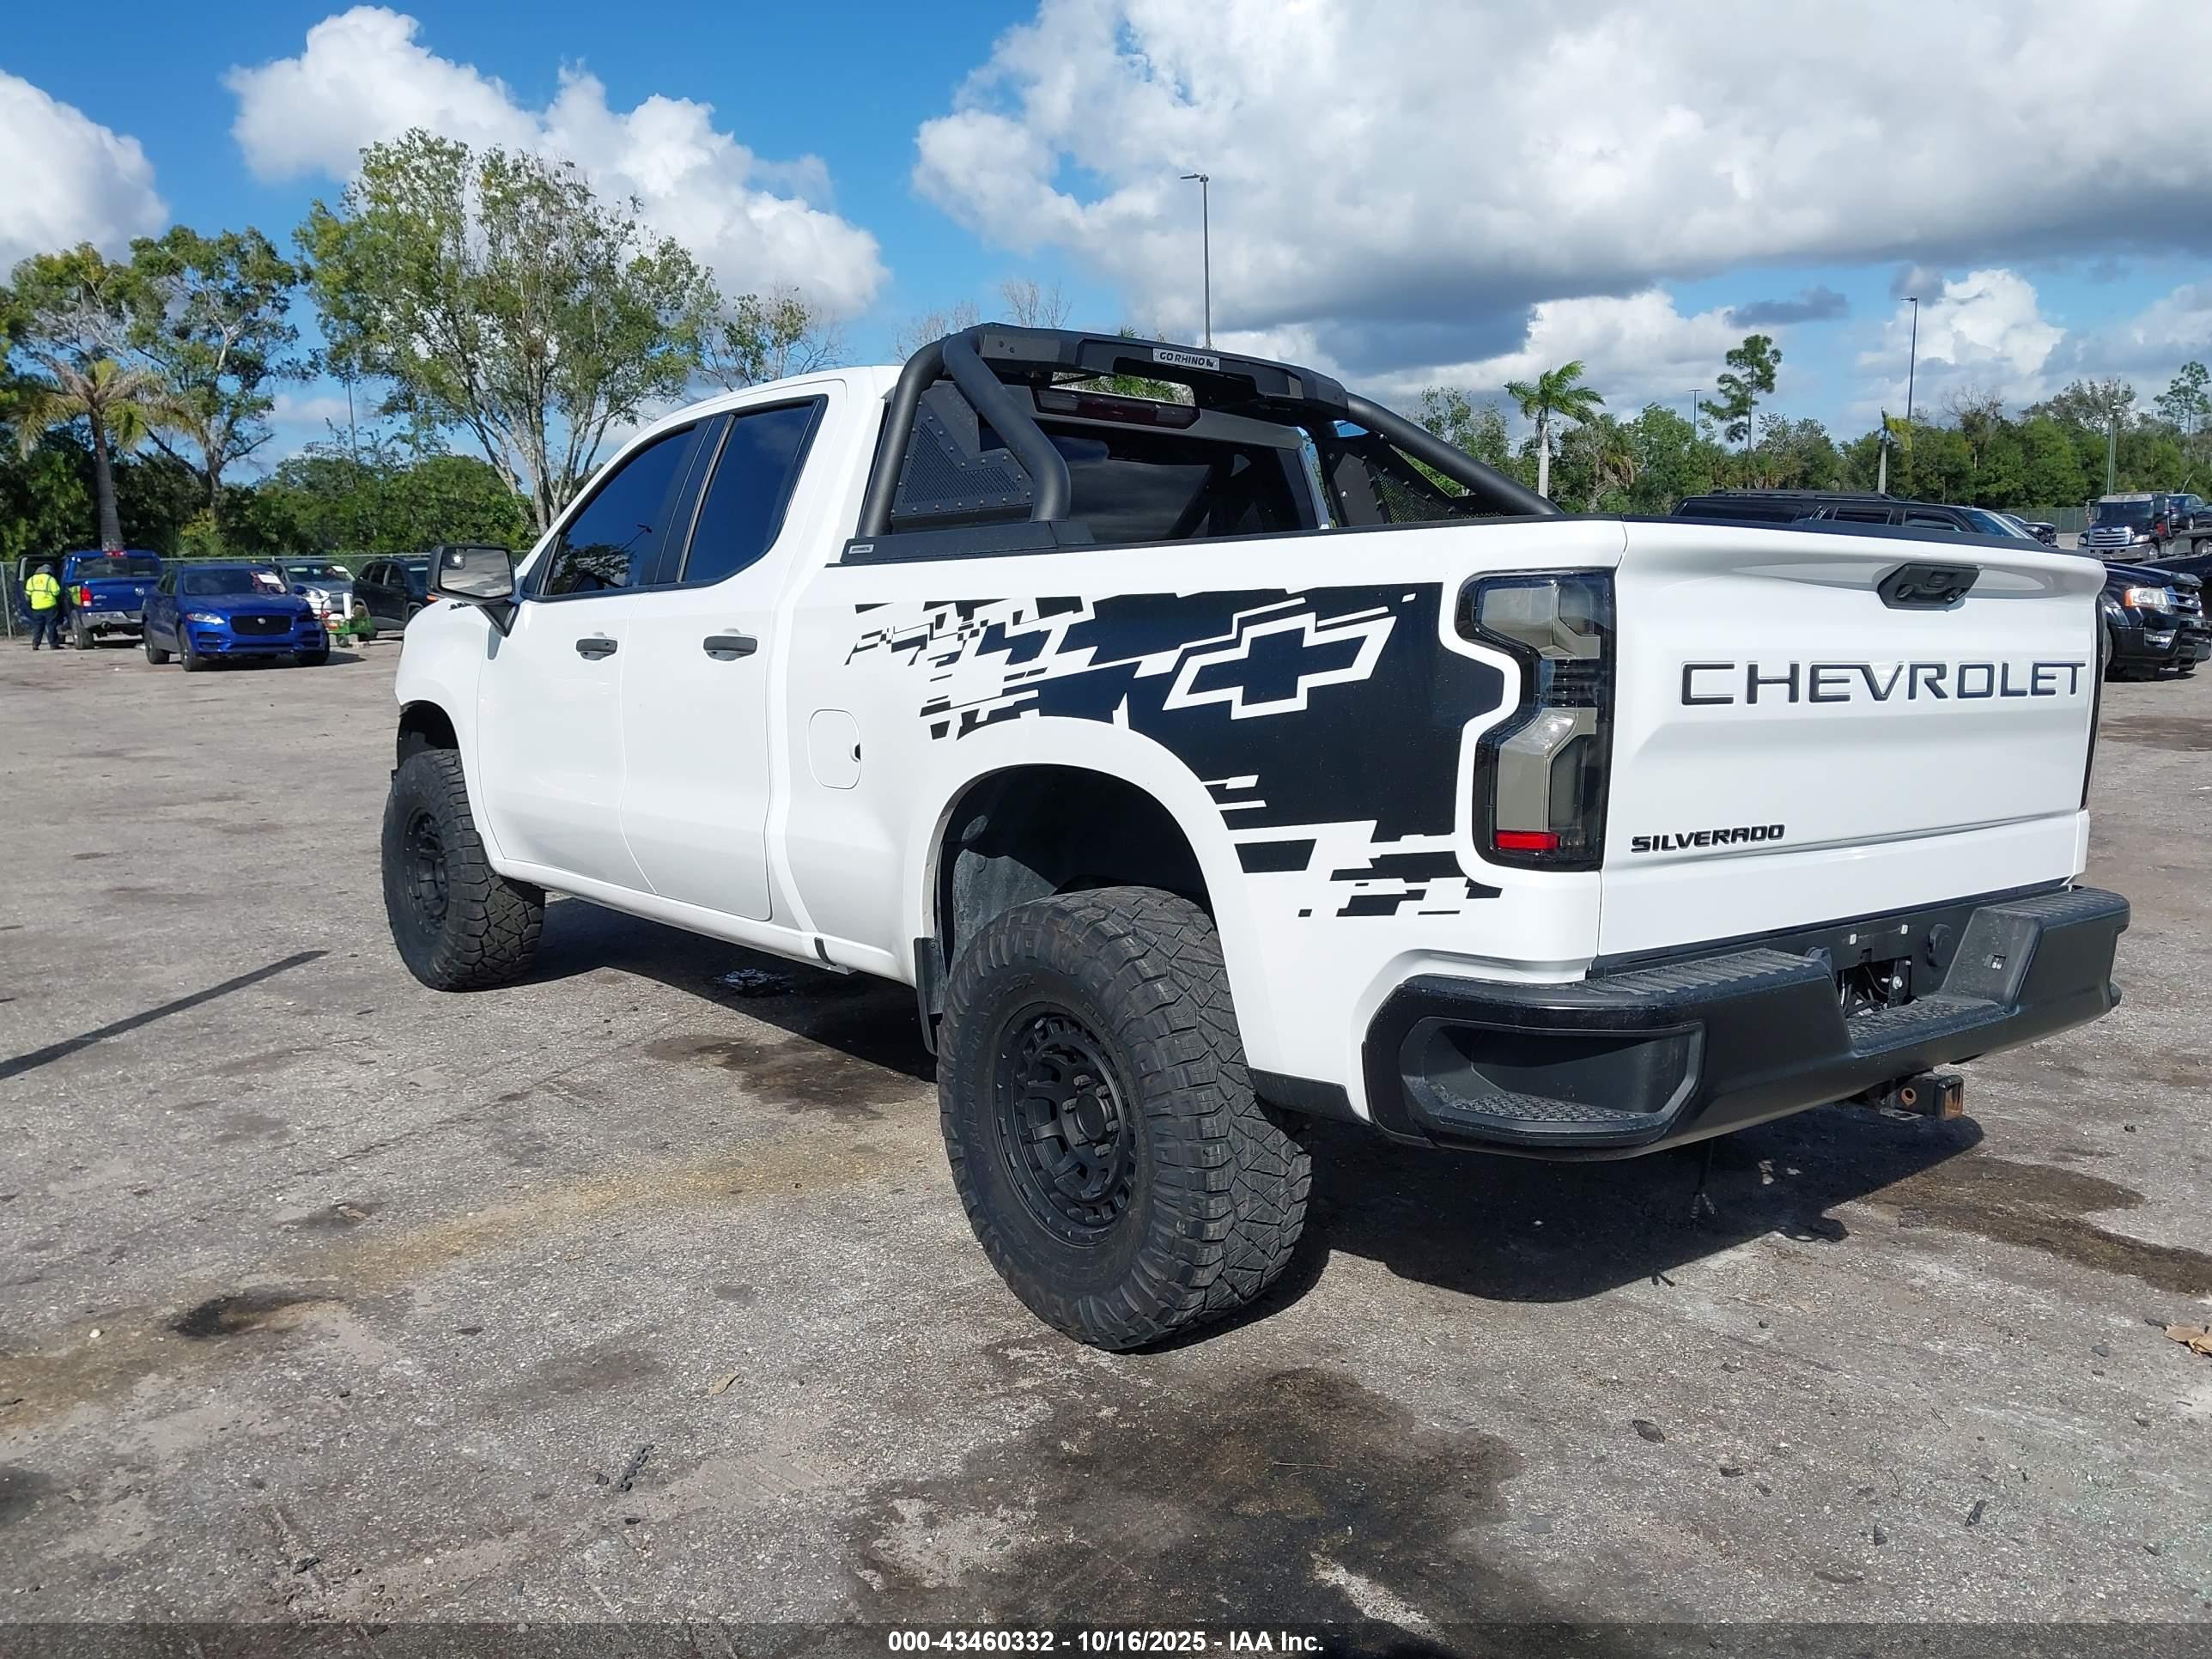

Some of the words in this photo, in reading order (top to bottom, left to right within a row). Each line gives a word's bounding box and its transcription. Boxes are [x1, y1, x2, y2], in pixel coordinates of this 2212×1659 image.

[1159, 351, 1174, 362] GO
[1175, 353, 1206, 366] RHINO
[1680, 660, 2087, 706] CHEVROLET
[1631, 823, 1786, 853] SILVERADO
